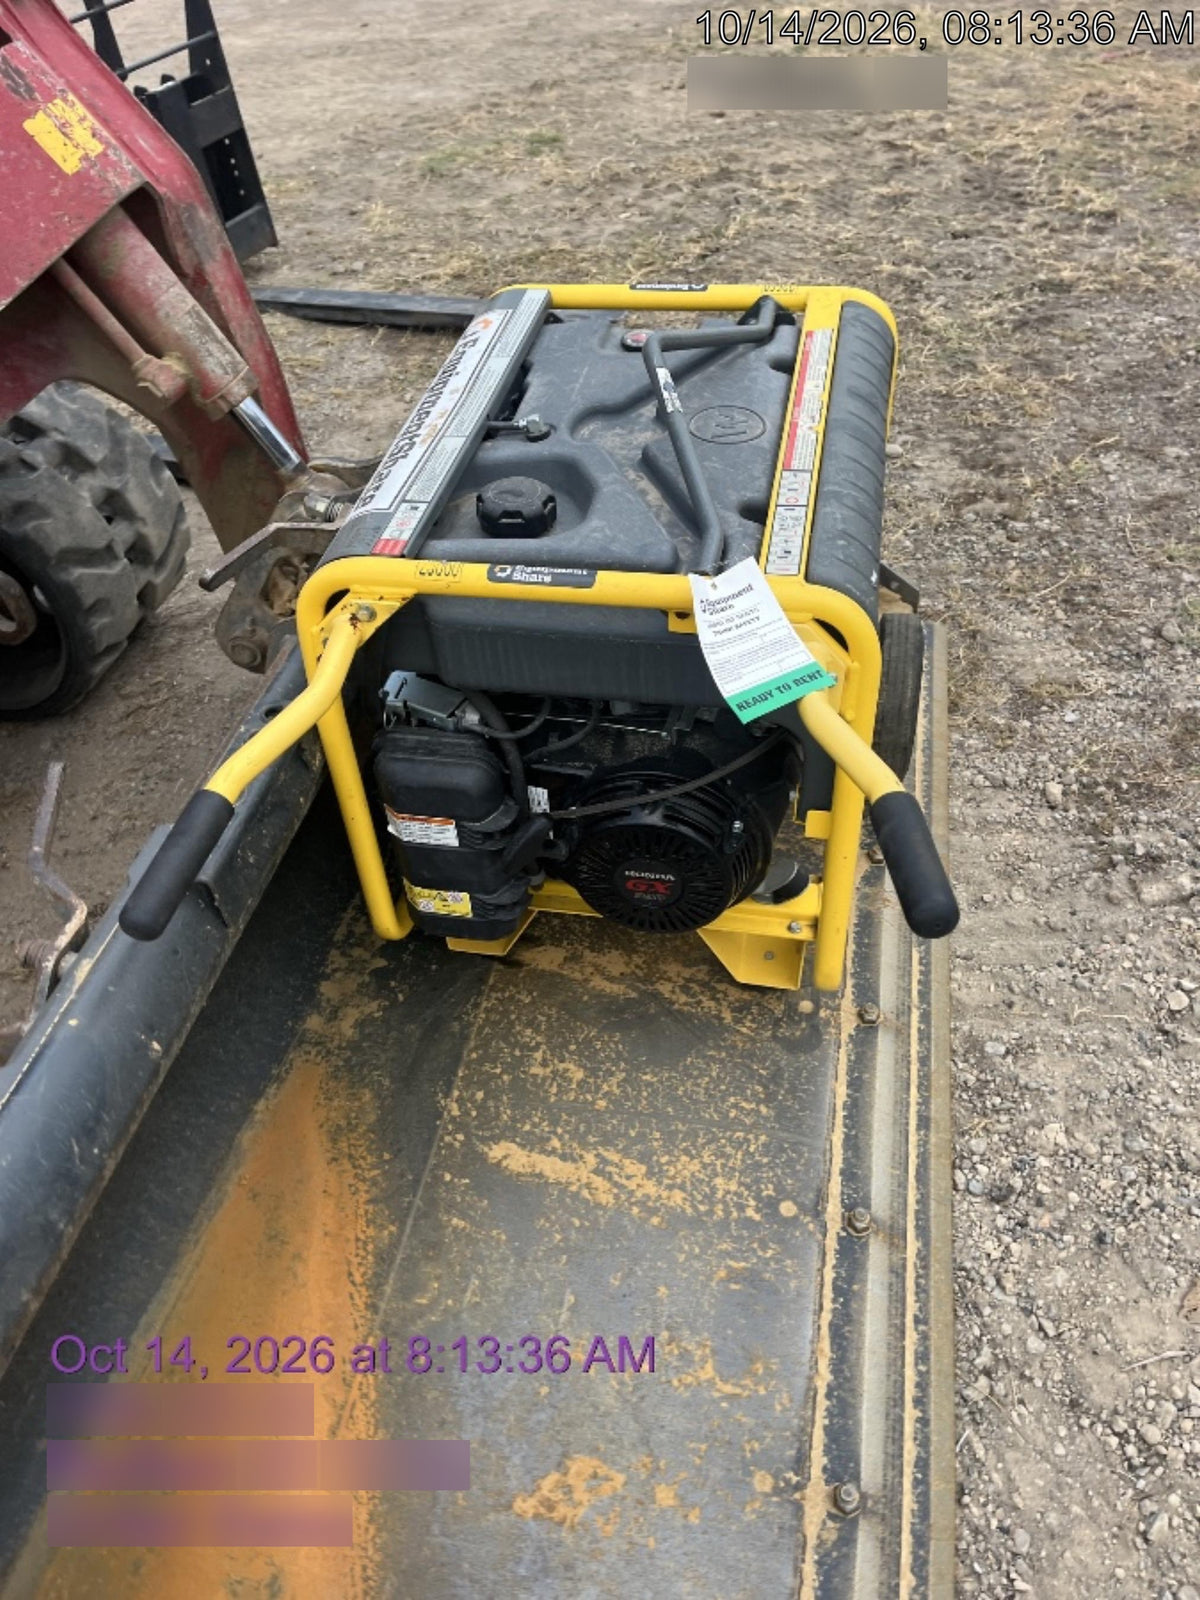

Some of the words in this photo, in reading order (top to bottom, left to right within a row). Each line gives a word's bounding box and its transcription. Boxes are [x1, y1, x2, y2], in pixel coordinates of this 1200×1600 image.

[511, 572, 552, 583] Share
[735, 690, 774, 712] READY
[775, 681, 793, 696] TO
[794, 669, 825, 688] RENT
